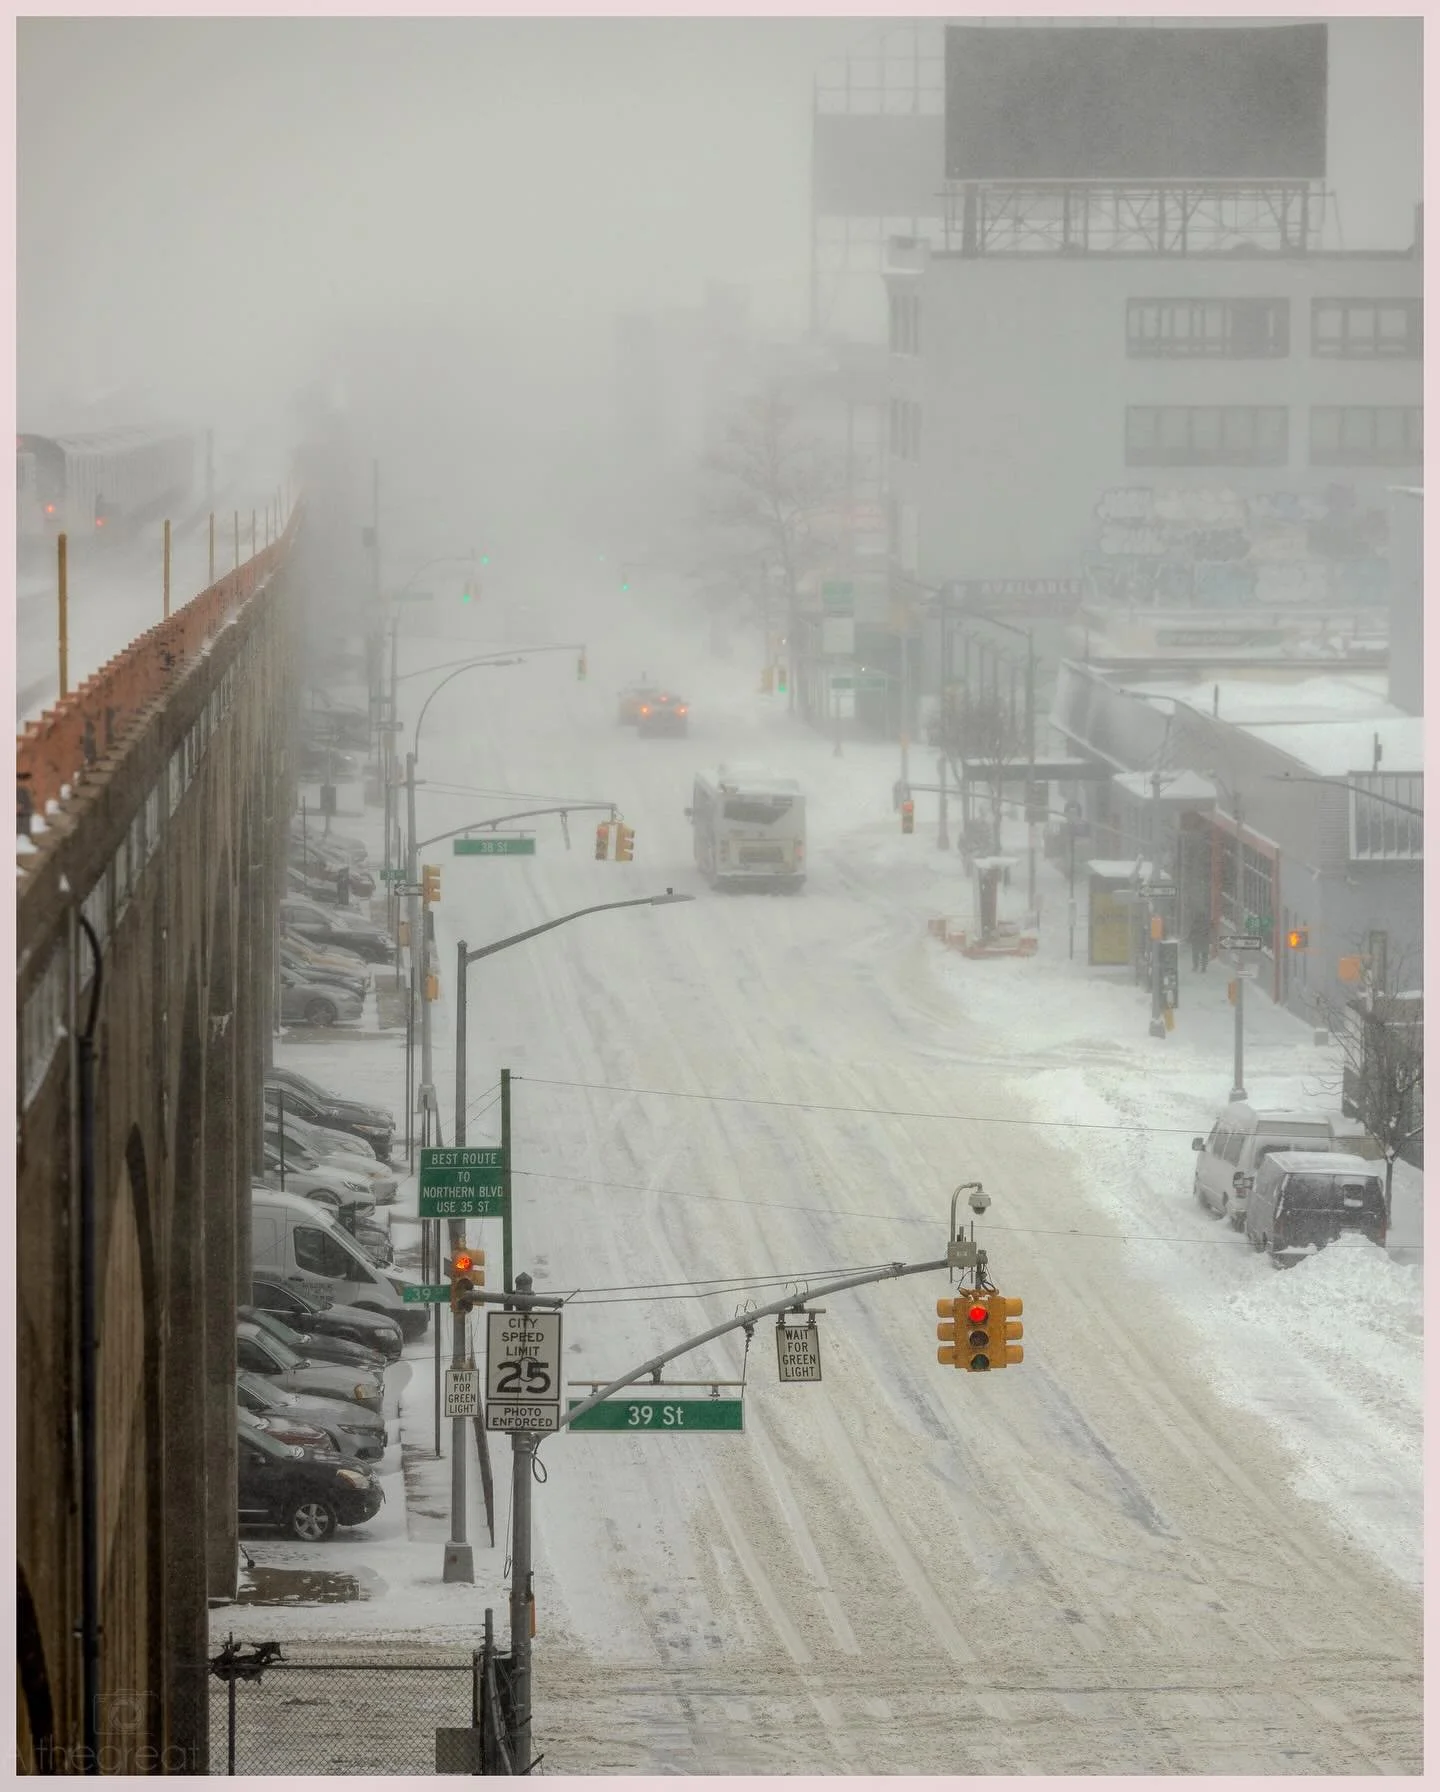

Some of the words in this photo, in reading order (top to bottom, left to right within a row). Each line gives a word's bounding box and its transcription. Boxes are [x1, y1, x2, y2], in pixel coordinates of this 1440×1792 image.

[480, 841, 494, 853] 38
[431, 1153, 458, 1165] BEST
[462, 1152, 497, 1165] ROUTE
[457, 1171, 471, 1183] TO
[423, 1186, 475, 1198] NORTHERN
[479, 1186, 503, 1198] BLVD
[436, 1201, 456, 1213] USE
[461, 1201, 473, 1213] 35
[478, 1201, 490, 1213] ST
[411, 1288, 431, 1301] 39
[508, 1318, 539, 1329] CITY
[501, 1332, 545, 1342] SPEED
[785, 1329, 809, 1340] WAIT
[506, 1346, 540, 1357] LIMIT
[787, 1342, 809, 1353] FOR
[782, 1354, 816, 1365] GREEN
[785, 1366, 815, 1377] LIGHT
[453, 1373, 473, 1383] WAIT
[496, 1361, 551, 1394] 25
[454, 1383, 471, 1393] FOR
[448, 1393, 476, 1403] GREEN
[449, 1404, 474, 1414] LIGHT
[504, 1407, 542, 1417] PHOTO
[628, 1405, 653, 1425] 39
[663, 1405, 684, 1425] St
[492, 1417, 553, 1427] ENFORCED
